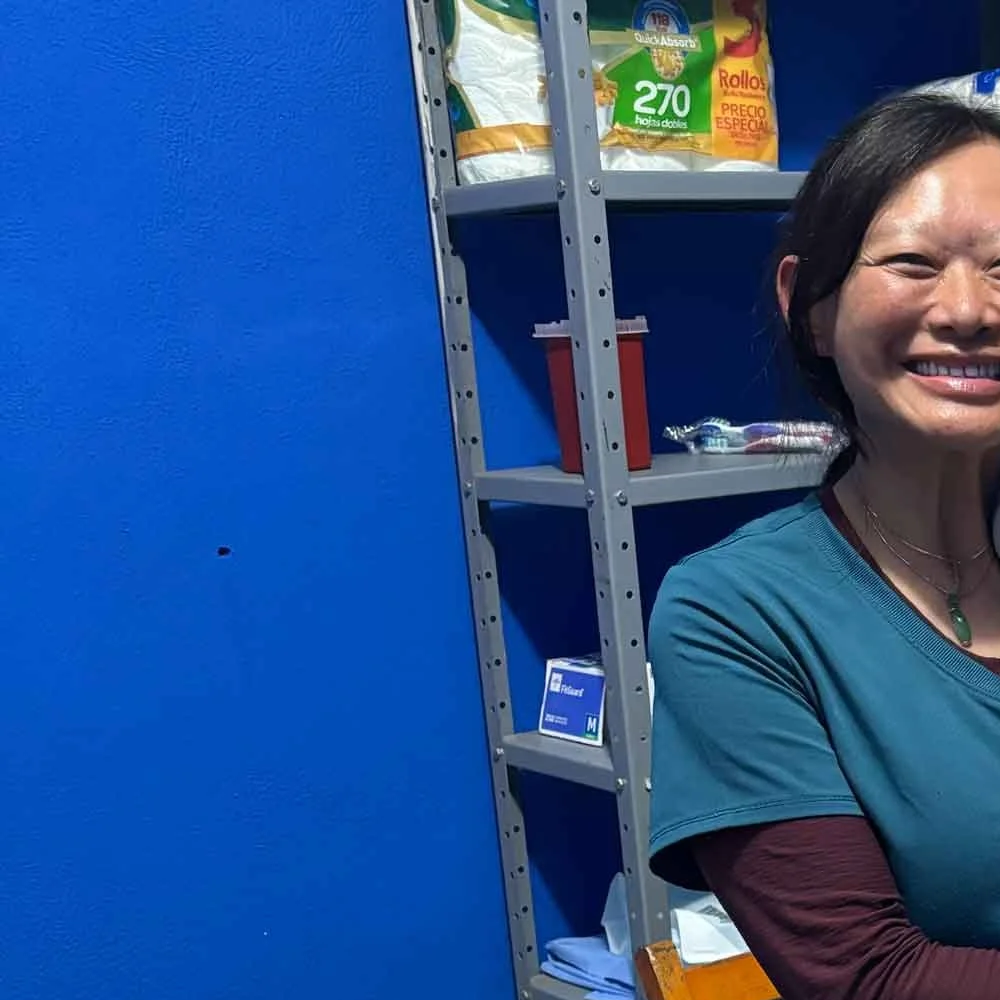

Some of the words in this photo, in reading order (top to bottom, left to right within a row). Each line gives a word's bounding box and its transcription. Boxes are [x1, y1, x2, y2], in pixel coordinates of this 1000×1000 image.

[718, 68, 767, 90] Rollos
[634, 80, 691, 117] 270
[720, 103, 767, 119] PRECIO
[635, 114, 661, 128] hojas
[587, 716, 597, 733] M
